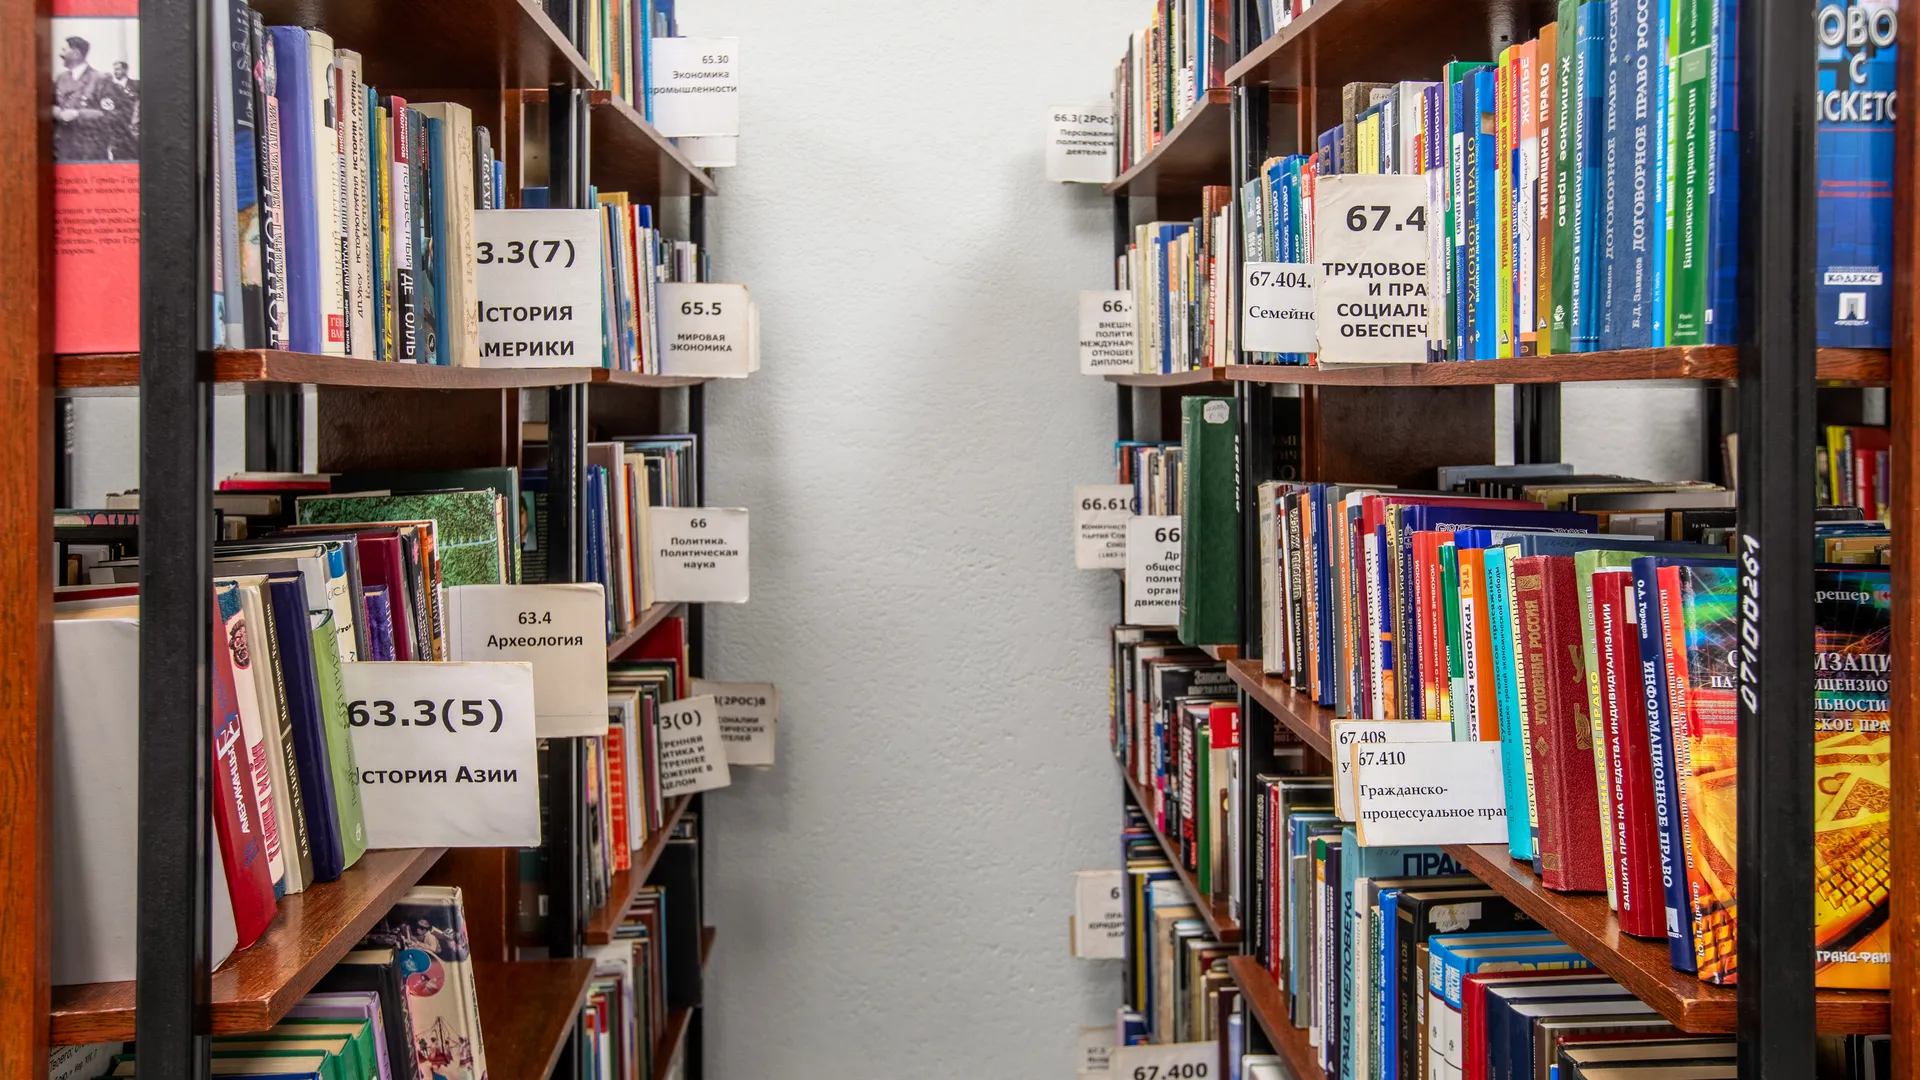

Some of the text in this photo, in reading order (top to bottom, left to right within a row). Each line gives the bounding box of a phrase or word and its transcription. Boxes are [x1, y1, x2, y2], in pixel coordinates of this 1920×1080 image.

[672, 70, 729, 80] Экономика
[702, 55, 729, 64] 65.30
[1850, 52, 1868, 84] С
[1521, 56, 1530, 125] ЖИЛЬЕ
[1539, 63, 1549, 123] ПРАВО
[1576, 51, 1585, 150] УПРАВЛЯЮЩАЯ
[1607, 70, 1617, 132] ПРАВО
[1635, 56, 1649, 120] ПРАВО
[1500, 126, 1508, 187] РОССИЙСКОЙ
[1556, 55, 1570, 227] Жилищное право
[1539, 127, 1549, 221] ЖИЛИЩНОЕ
[1632, 124, 1648, 252] ДОГОВОРНОЕ
[1682, 88, 1697, 269] Банковское право России
[1346, 205, 1426, 232] 67.4
[1574, 151, 1583, 246] ОРГАНИЗАЦИЯ
[1605, 137, 1617, 259] ДОГОВОРНОЕ
[1467, 137, 1477, 328] ТРУДОВОЕ ПРАВО
[1250, 271, 1312, 288] 67.404.
[1322, 262, 1426, 278] ТРУДОВОЕ
[1369, 283, 1382, 296] И
[1632, 257, 1643, 302] Завидов
[400, 272, 416, 356] ДЕ ГОЛЛЬ
[681, 301, 722, 316] 65.5
[1103, 300, 1132, 312] 66.
[669, 343, 733, 352] ЭКОНОМИКА
[677, 333, 726, 342] МИРОВАЯ
[670, 536, 727, 546] Политика.
[690, 518, 707, 528] 66
[660, 548, 738, 558] Политическая
[683, 560, 715, 570] наука
[1165, 551, 1181, 563] Др
[518, 611, 552, 625] 63.4
[1488, 567, 1499, 641] присяжных
[1815, 590, 1870, 604] решер
[487, 634, 583, 650] Археология
[1660, 588, 1675, 660] ДЕЯТЕЛЬНОСТИ
[1740, 533, 1761, 714] 07100261
[1465, 603, 1478, 742] ТРУДОВОЙ КОДЕКС
[1493, 642, 1502, 695] голосов
[1525, 599, 1548, 726] УГОЛОВНАЯ РОССИЯ
[1590, 670, 1604, 731] ПРАВО
[1675, 676, 1685, 708] ПРАВО
[347, 698, 503, 733] 63.3(5)
[1339, 731, 1386, 745] 67.408
[1637, 579, 1673, 888] О.А. Городов ИНФОРМАЦИОННОЕ ПРАВО
[1358, 751, 1406, 767] 67.410
[1602, 603, 1630, 911] ЗАЩИТА ПРАВ НА СРЕДСТВА ИНДИВИДУАЛИЗАЦИИ
[1680, 710, 1692, 767] АВТОРСКОЕ
[1360, 784, 1448, 800] Гражданско-
[1595, 735, 1614, 891] ЭКОЛОГИЧЕСКОЕ
[1362, 807, 1475, 823] процессуальное
[1681, 796, 1694, 870] ОРГАНИЗАЦИЯ
[1692, 881, 1703, 923] Дрешер
[1343, 890, 1353, 1009] ЧЕЛОВЕКА
[1134, 1062, 1208, 1080] 67.400
